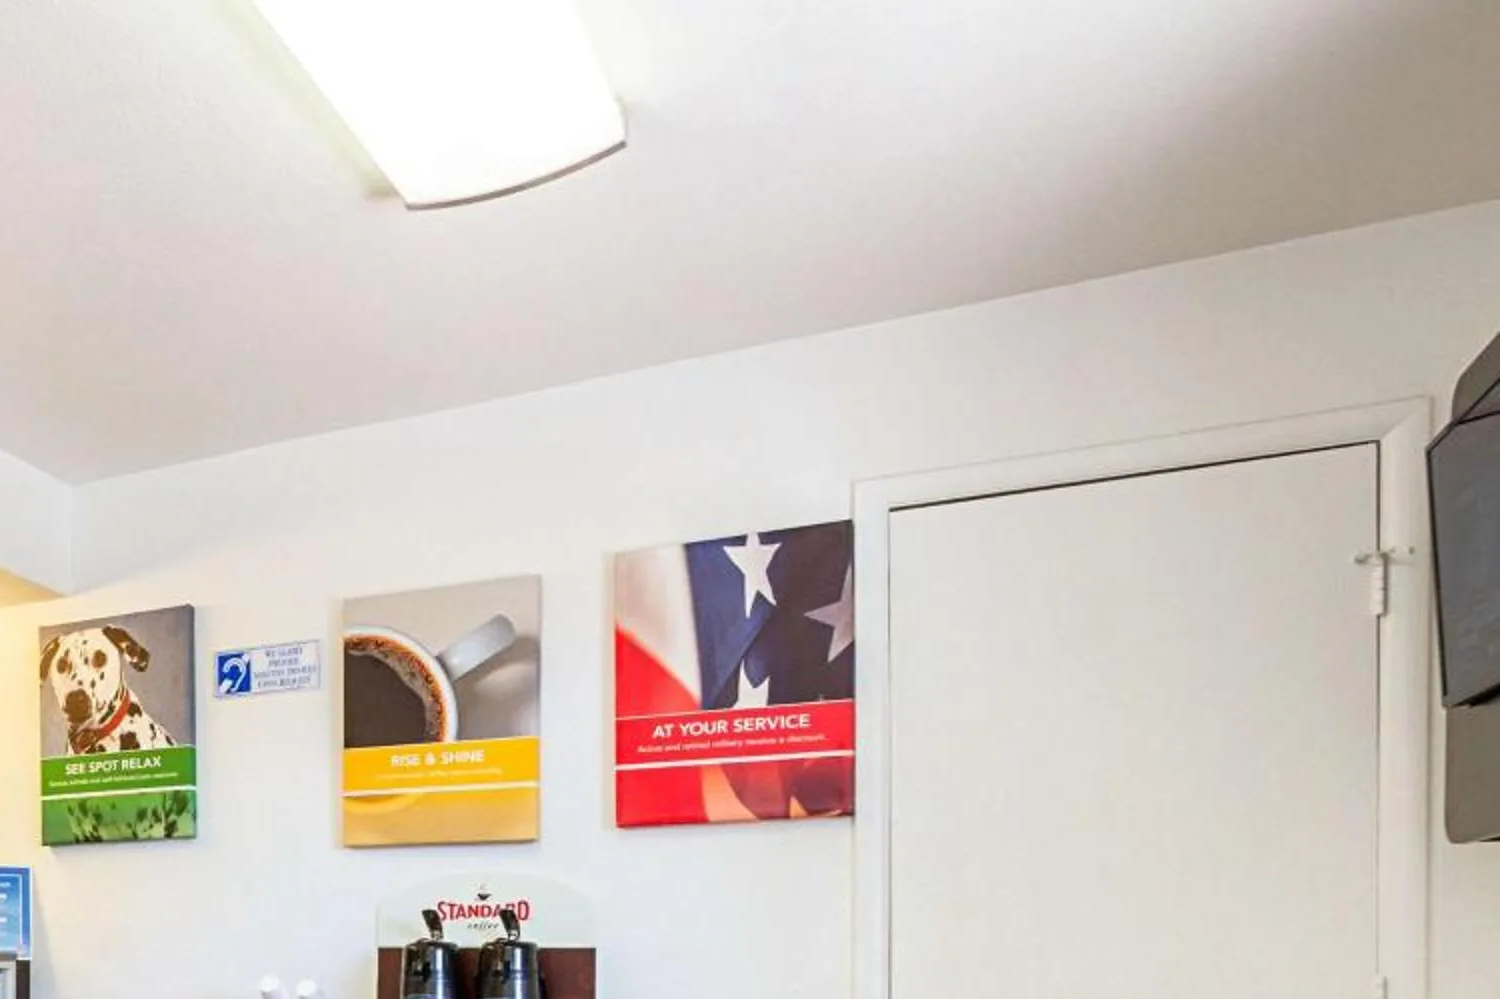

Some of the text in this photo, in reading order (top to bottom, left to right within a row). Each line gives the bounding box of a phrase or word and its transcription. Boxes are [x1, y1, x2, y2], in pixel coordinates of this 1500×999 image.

[652, 714, 811, 739] AT YOUR SERVICE
[65, 756, 162, 775] SEE SPOT RELAX
[391, 750, 485, 767] RISE & SHINE
